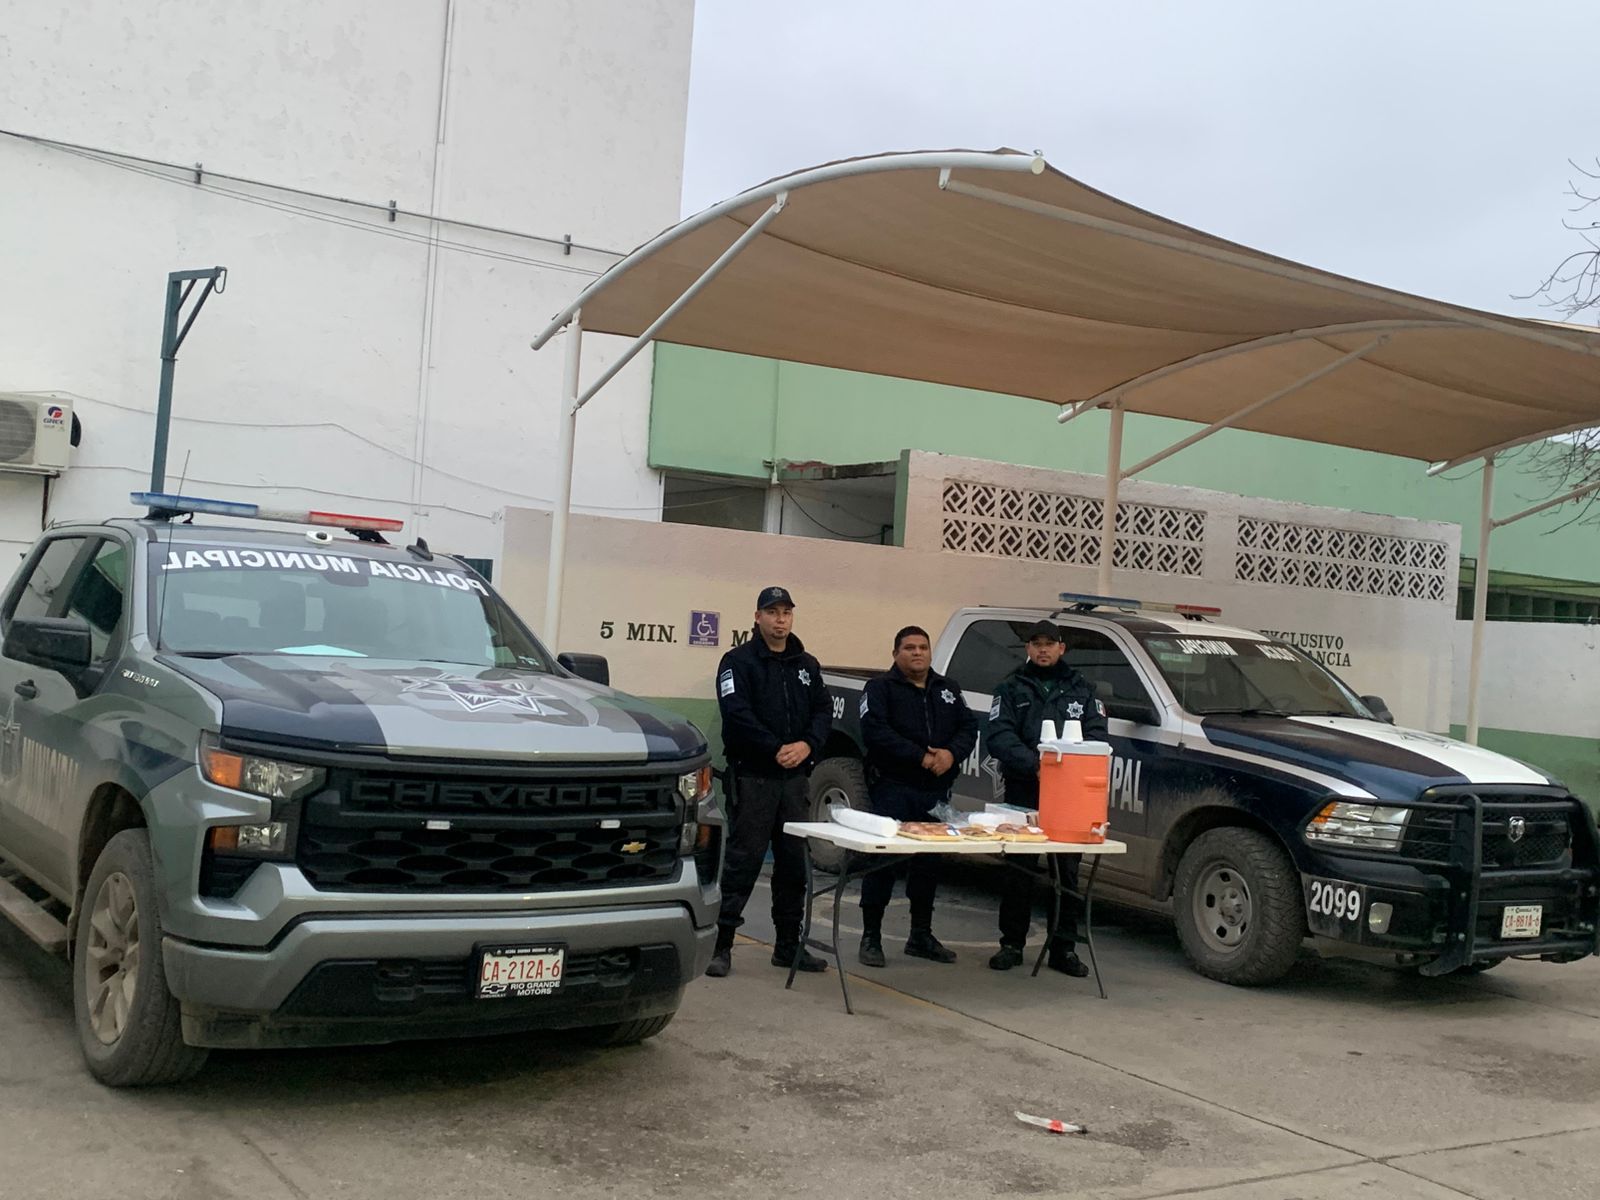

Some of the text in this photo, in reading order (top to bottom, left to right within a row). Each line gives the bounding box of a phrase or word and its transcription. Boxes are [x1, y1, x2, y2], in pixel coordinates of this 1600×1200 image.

[600, 621, 614, 639] 5
[626, 622, 677, 643] MIN.
[1309, 881, 1361, 921] 2099
[482, 959, 561, 982] CA-212A-6
[517, 987, 552, 996] MOTORS
[527, 981, 560, 989] GRANDE
